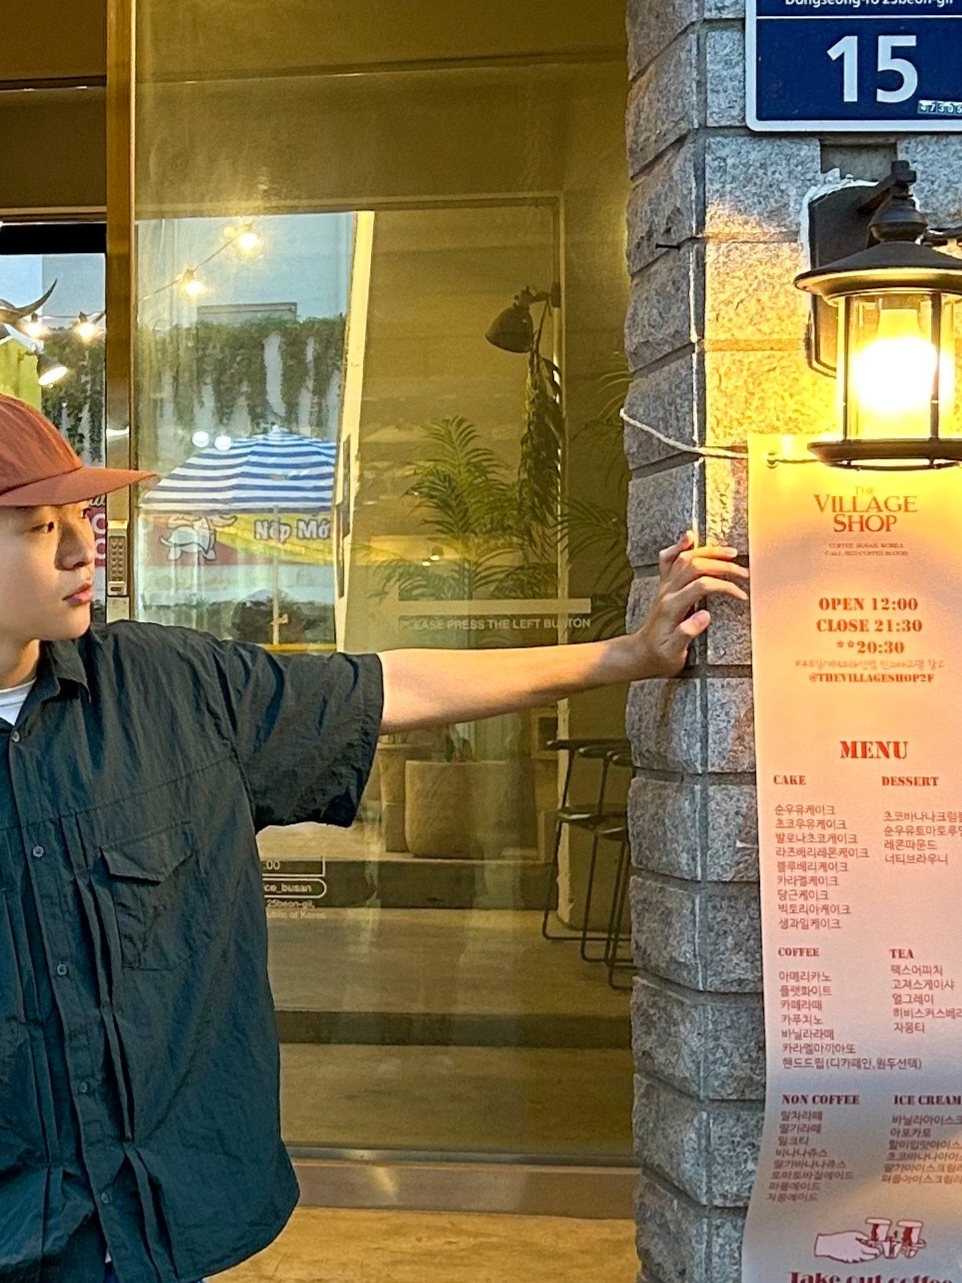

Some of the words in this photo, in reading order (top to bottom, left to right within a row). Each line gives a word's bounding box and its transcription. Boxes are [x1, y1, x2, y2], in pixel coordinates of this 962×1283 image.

[826, 35, 919, 104] 15
[814, 494, 918, 513] VILLAGE
[833, 514, 898, 533] SHOP
[819, 598, 864, 612] OPEN
[872, 598, 919, 612] 12:00
[447, 619, 485, 630] PRESS
[487, 619, 510, 629] THE
[513, 618, 541, 629] LEFT
[544, 617, 591, 629] BUTON
[816, 619, 869, 632] CLOSE
[874, 619, 923, 633] 21:30
[809, 673, 935, 683] @THEVILLAGESHOP2F
[840, 741, 909, 760] MENU
[773, 774, 807, 786] CAKE
[881, 775, 940, 787] DESSERT
[774, 804, 836, 817] 순우유케이크
[775, 818, 848, 831] 초코우유케이크
[262, 860, 281, 871] :00
[884, 852, 949, 866] 너티브라우니
[776, 860, 850, 873] 블루베리케이크
[264, 883, 313, 894] ce_busan
[777, 889, 830, 902] 당근케이크
[778, 903, 852, 916] 빅토리아케이크
[778, 917, 842, 930] 생과일케이크
[777, 946, 820, 957] COFFEE
[889, 948, 914, 959] TEA
[778, 970, 833, 983] 아메리카노
[779, 984, 833, 998] 플랫화이트
[891, 992, 934, 1006] 얼그레이
[780, 1012, 824, 1026] 카푸치노
[892, 1021, 926, 1034] 자몽티
[781, 1093, 808, 1105] NON
[811, 1093, 860, 1105] COFFEE
[893, 1094, 916, 1106] ICE
[918, 1094, 962, 1106] CREAM
